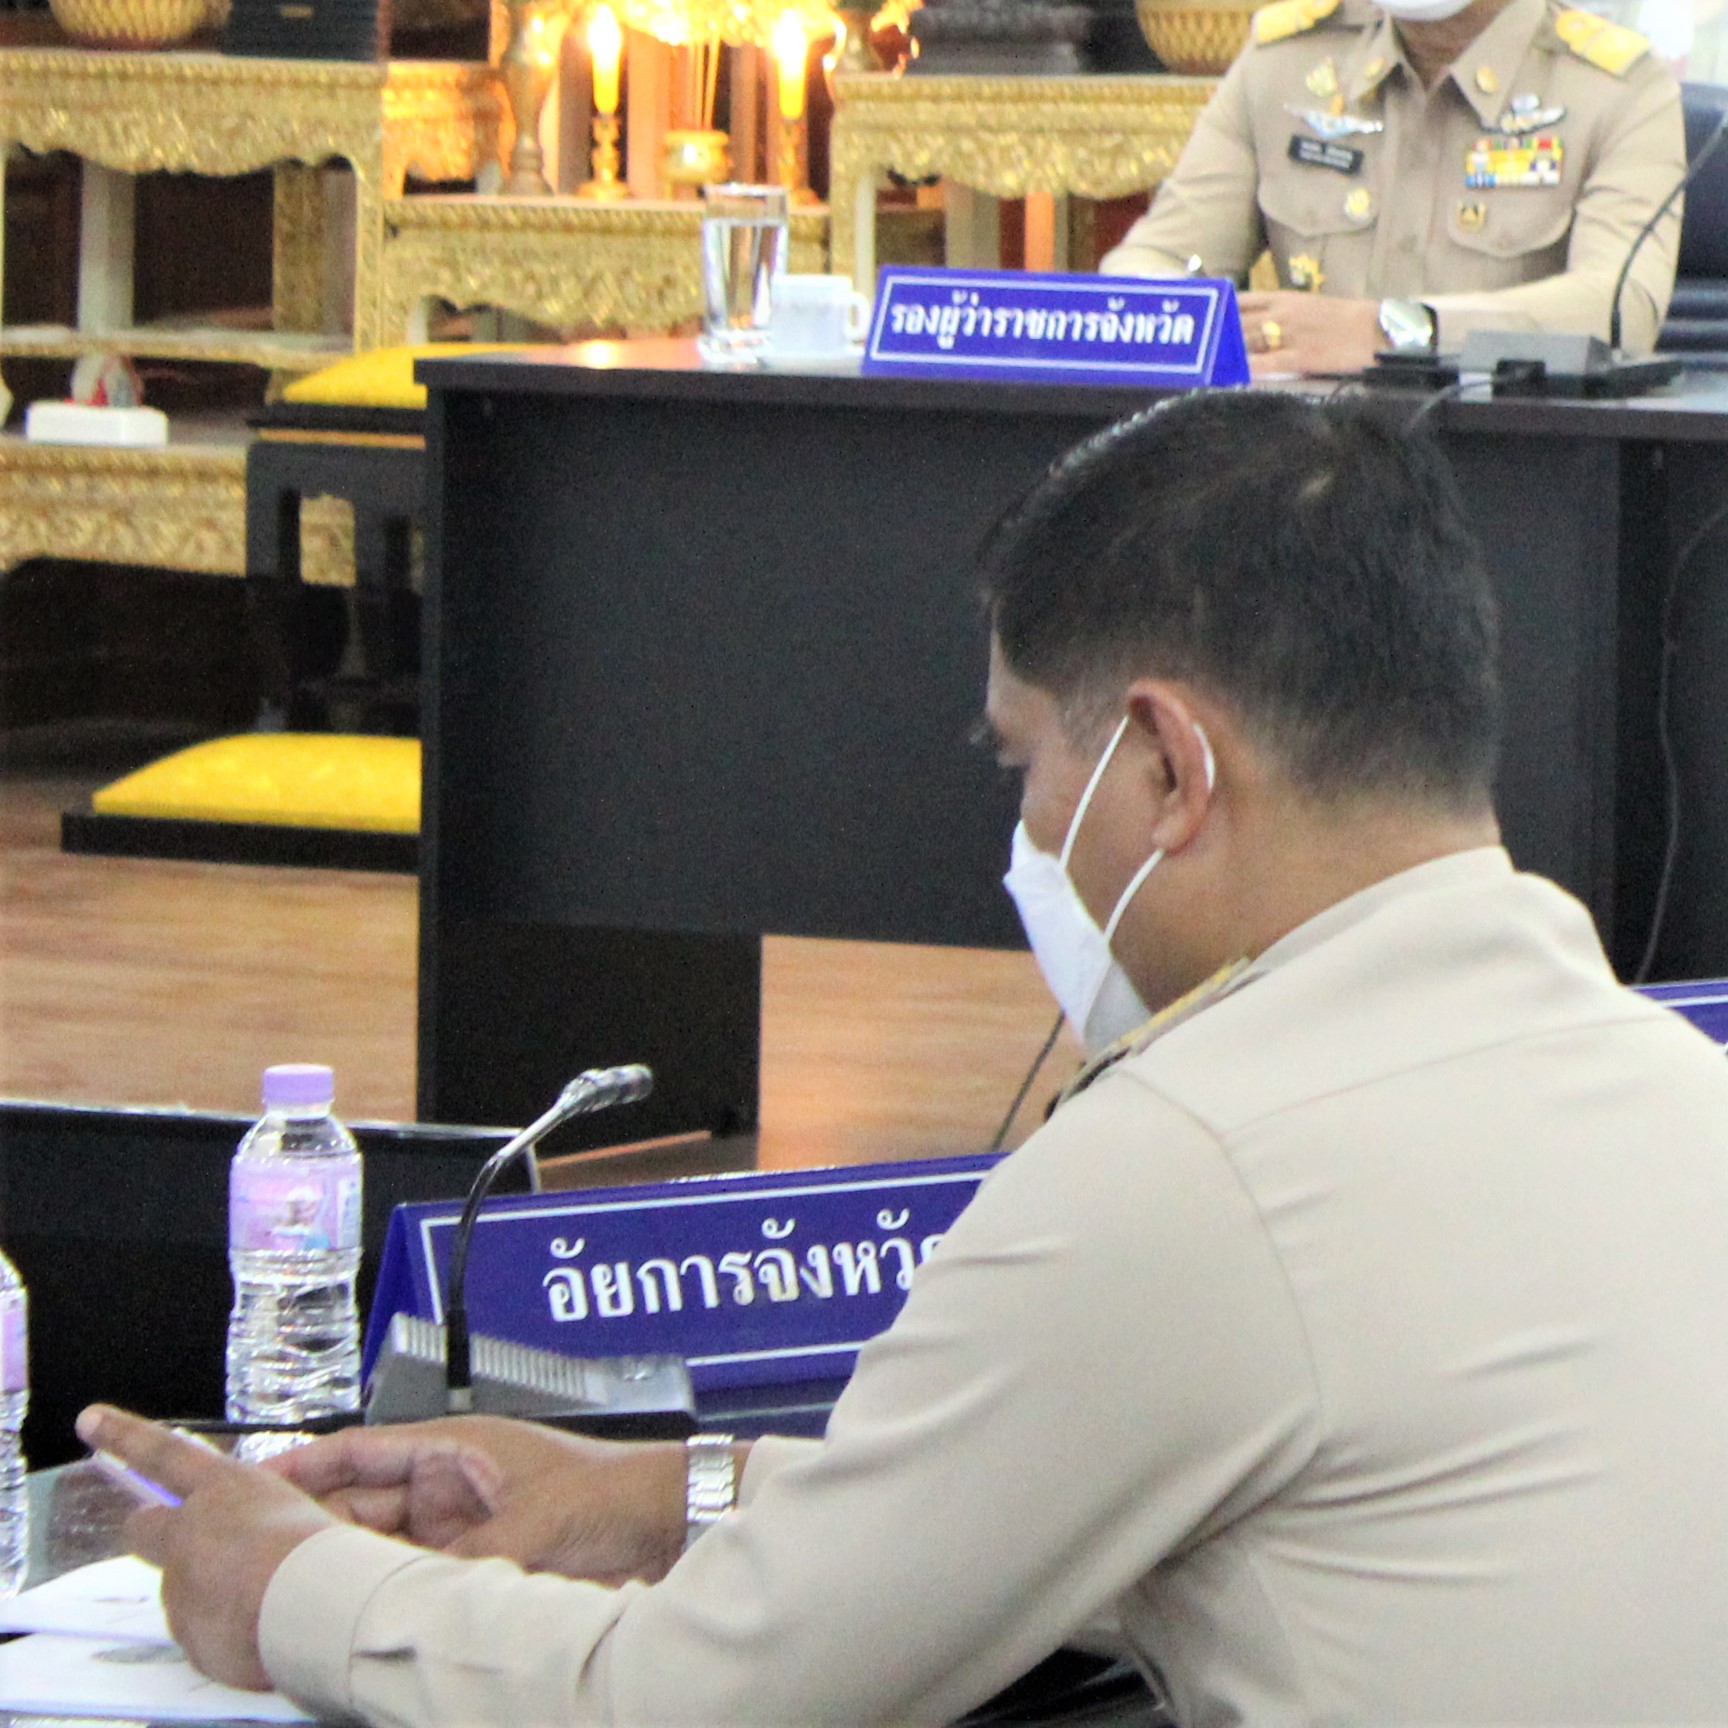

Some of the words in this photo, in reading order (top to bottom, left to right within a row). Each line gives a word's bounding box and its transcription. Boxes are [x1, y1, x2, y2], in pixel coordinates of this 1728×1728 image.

[891, 289, 1195, 350] รองผู้ว่าราชการจังหวัด
